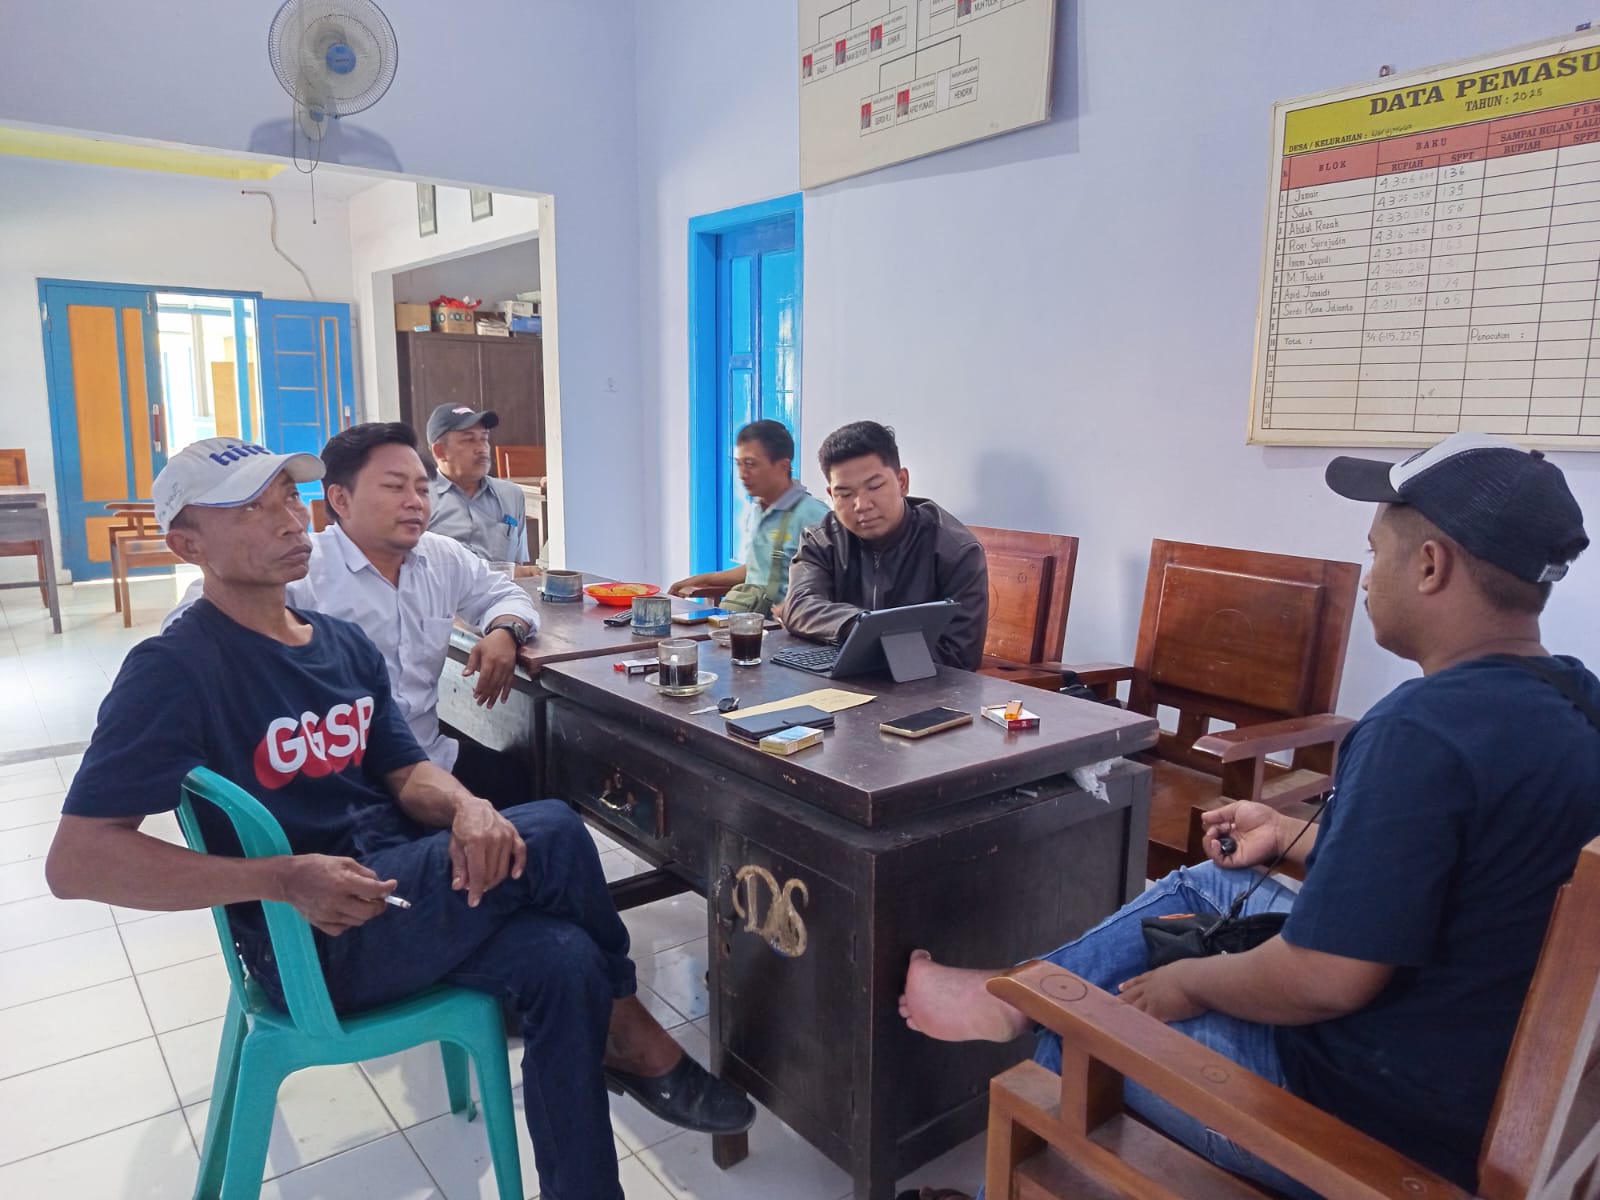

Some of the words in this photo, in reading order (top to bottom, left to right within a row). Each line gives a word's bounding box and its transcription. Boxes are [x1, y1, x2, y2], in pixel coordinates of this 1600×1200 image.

[1369, 85, 1445, 116] DATA
[1455, 52, 1600, 99] PEMASU
[1465, 95, 1502, 112] TAHUN
[1512, 87, 1543, 103] 2025
[1500, 128, 1538, 142] SAMPAI
[1539, 121, 1573, 135] BULAN
[1573, 131, 1600, 142] SPPT
[1288, 143, 1308, 153] DESA
[1314, 132, 1363, 148] KELURAHAN
[1416, 138, 1447, 151] BAKU
[1504, 140, 1541, 154] RUPIAH
[1451, 151, 1475, 163] SPPT
[1318, 160, 1347, 172] BLOK
[1392, 159, 1424, 172] RUPIAH
